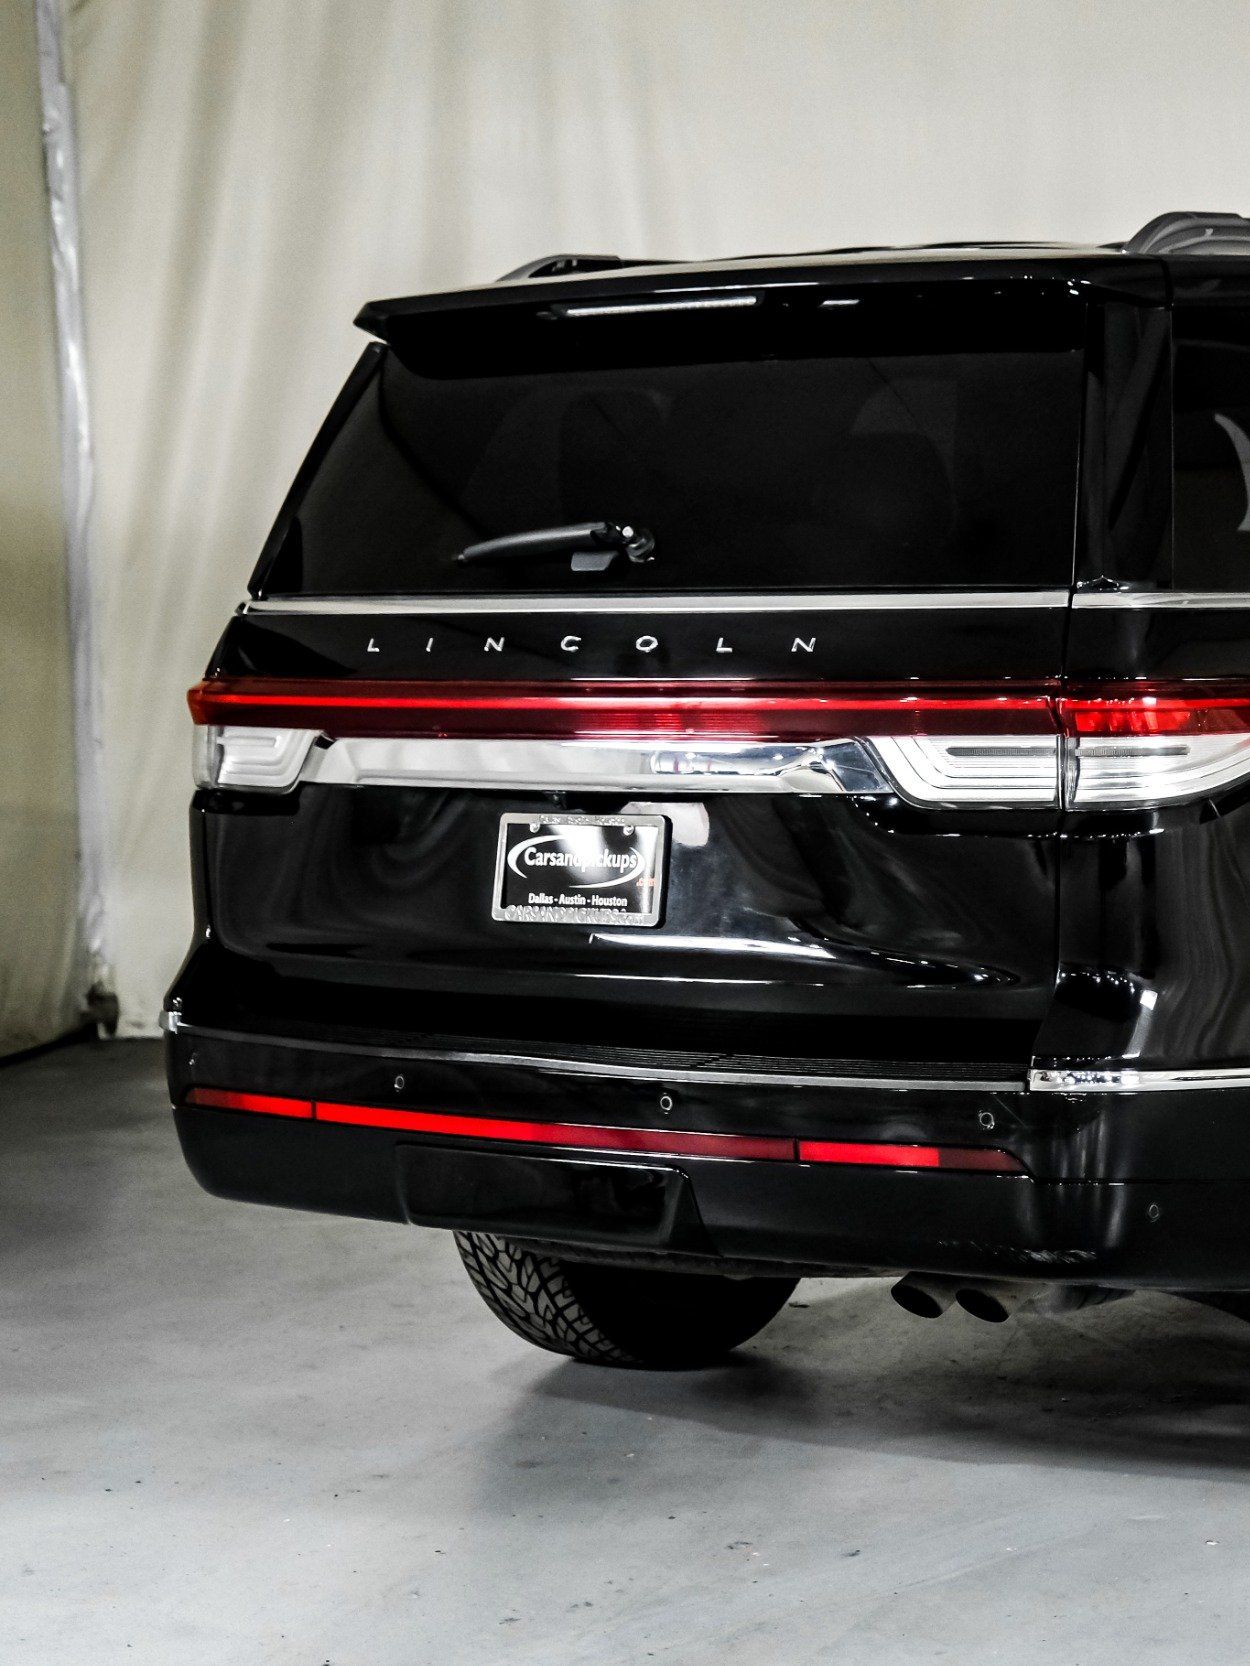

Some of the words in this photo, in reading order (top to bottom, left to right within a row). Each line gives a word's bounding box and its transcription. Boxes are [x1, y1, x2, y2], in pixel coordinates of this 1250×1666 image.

[367, 635, 816, 653] LINCOLN
[524, 846, 637, 873] Carsandpckups
[528, 893, 554, 904] Dallas
[559, 894, 586, 905] Austin
[592, 895, 628, 907] Houston
